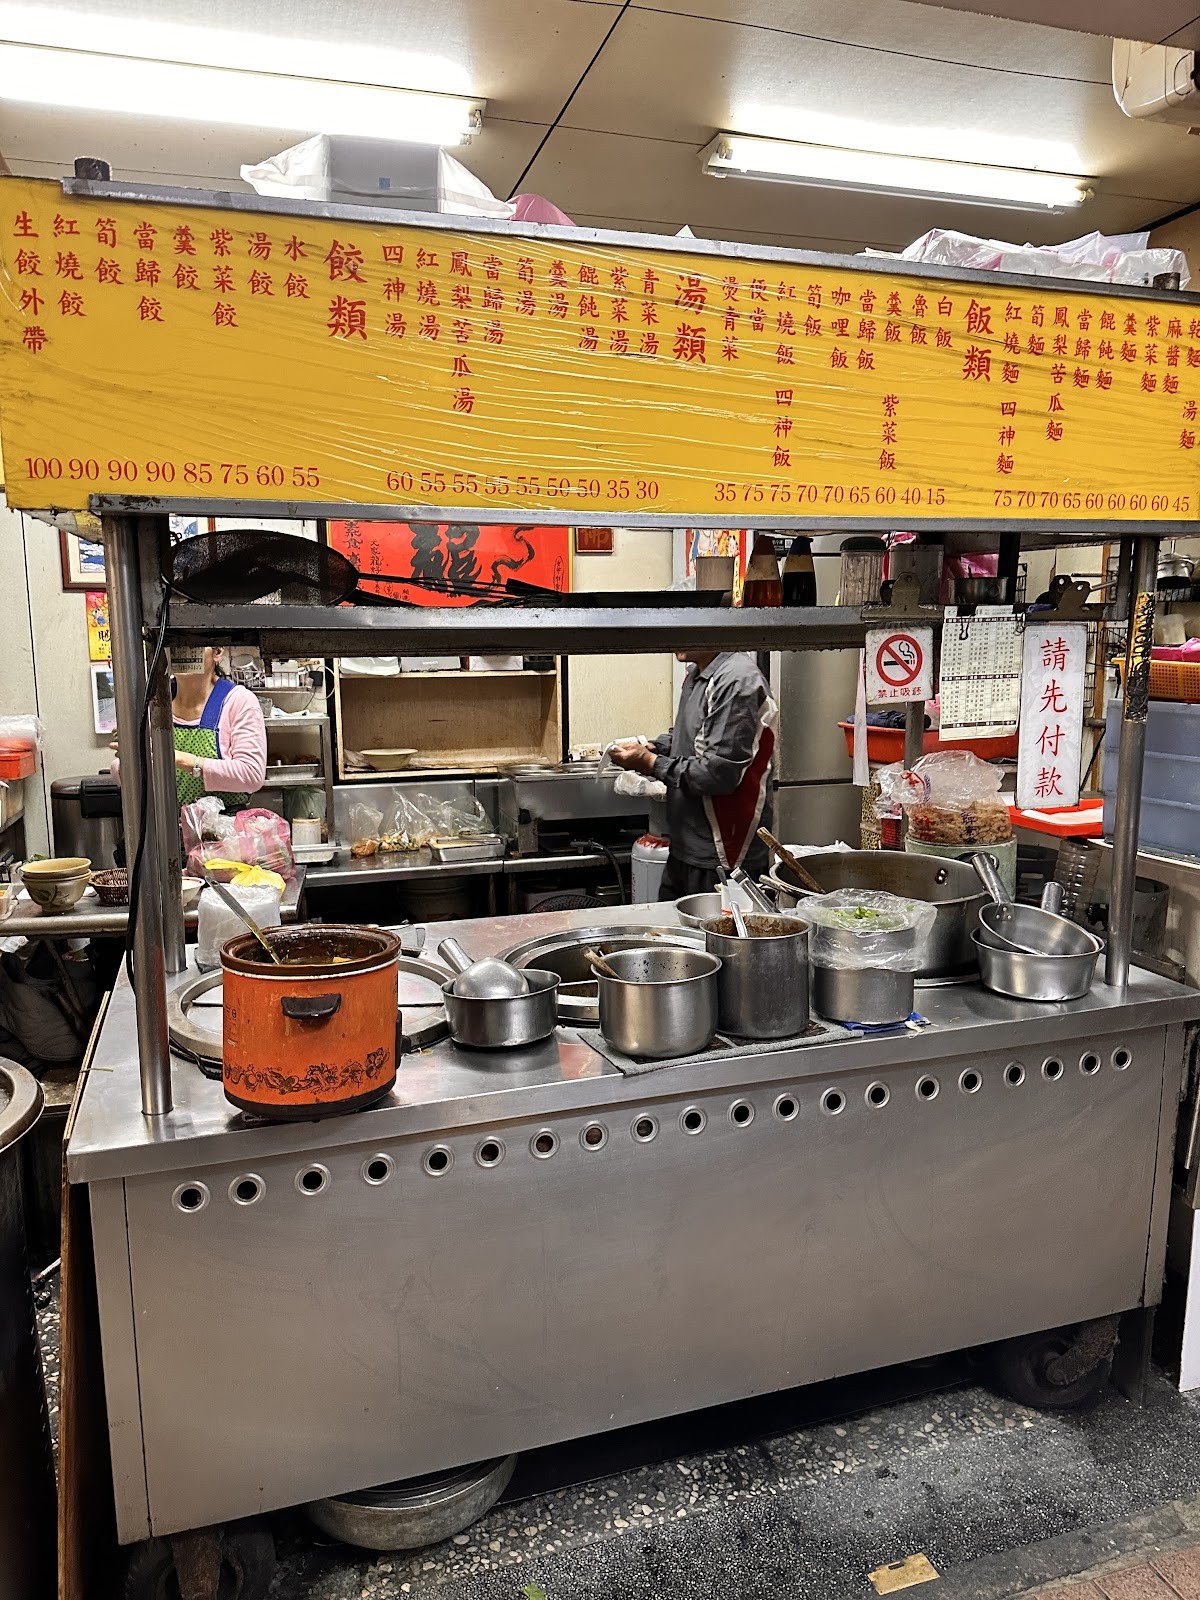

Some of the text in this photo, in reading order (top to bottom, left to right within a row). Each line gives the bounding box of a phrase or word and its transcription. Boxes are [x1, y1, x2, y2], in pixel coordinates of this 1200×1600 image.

[14, 209, 49, 355] 生餃外帶
[53, 213, 87, 319] 紅燒餃
[95, 217, 125, 287] 筍餃
[134, 221, 165, 324] 當歸餃
[210, 228, 239, 329] 紫菜餃
[248, 232, 275, 297] 湯餃
[284, 235, 311, 299] 水餃
[325, 239, 368, 342] 餃類
[382, 244, 407, 339] 四神湯
[516, 257, 536, 317] 筍湯
[417, 247, 441, 342] 紅燒湯
[483, 254, 504, 345] 當歸湯
[577, 265, 599, 353] 餛飩湯
[609, 266, 630, 355] 紫菜湯
[640, 269, 659, 357] 青菜湯
[673, 273, 707, 364] 湯類
[721, 276, 740, 362] 燙青菜
[750, 279, 769, 333] 便當
[776, 282, 796, 366] 紅燒飯
[804, 285, 823, 338] 筍飯
[830, 287, 850, 369] 咖哩飯
[857, 290, 876, 371] 當歸飯
[910, 294, 929, 346] 魯飯
[935, 297, 953, 349] 白飯
[1027, 305, 1045, 356] 筍麵
[962, 299, 995, 383] 飯類
[1002, 302, 1021, 384] 紅燒麵
[1046, 307, 1069, 441] 鳳梨苦瓜麵
[1073, 309, 1092, 389] 當歸麵
[1096, 310, 1115, 390] 餛飩麵
[1141, 316, 1160, 393] 紫菜麵
[1163, 318, 1183, 394] 麻醬麵
[772, 389, 794, 467] 四神飯
[879, 395, 899, 471] 紫菜飯
[997, 401, 1017, 475] 四神麵
[1180, 401, 1199, 450] 湯麵
[26, 457, 320, 489] 100 90 90 90 85 75 60 55
[387, 471, 660, 500] 60 55 55 55 55 50 50 35 30
[715, 482, 945, 506] 35 75 75 70 70 65 60 40 15
[994, 489, 1190, 512] 75 70 70 65 60 60 60 60 45
[877, 686, 922, 699] 禁止吸菸
[1034, 636, 1070, 798] 請先付款
